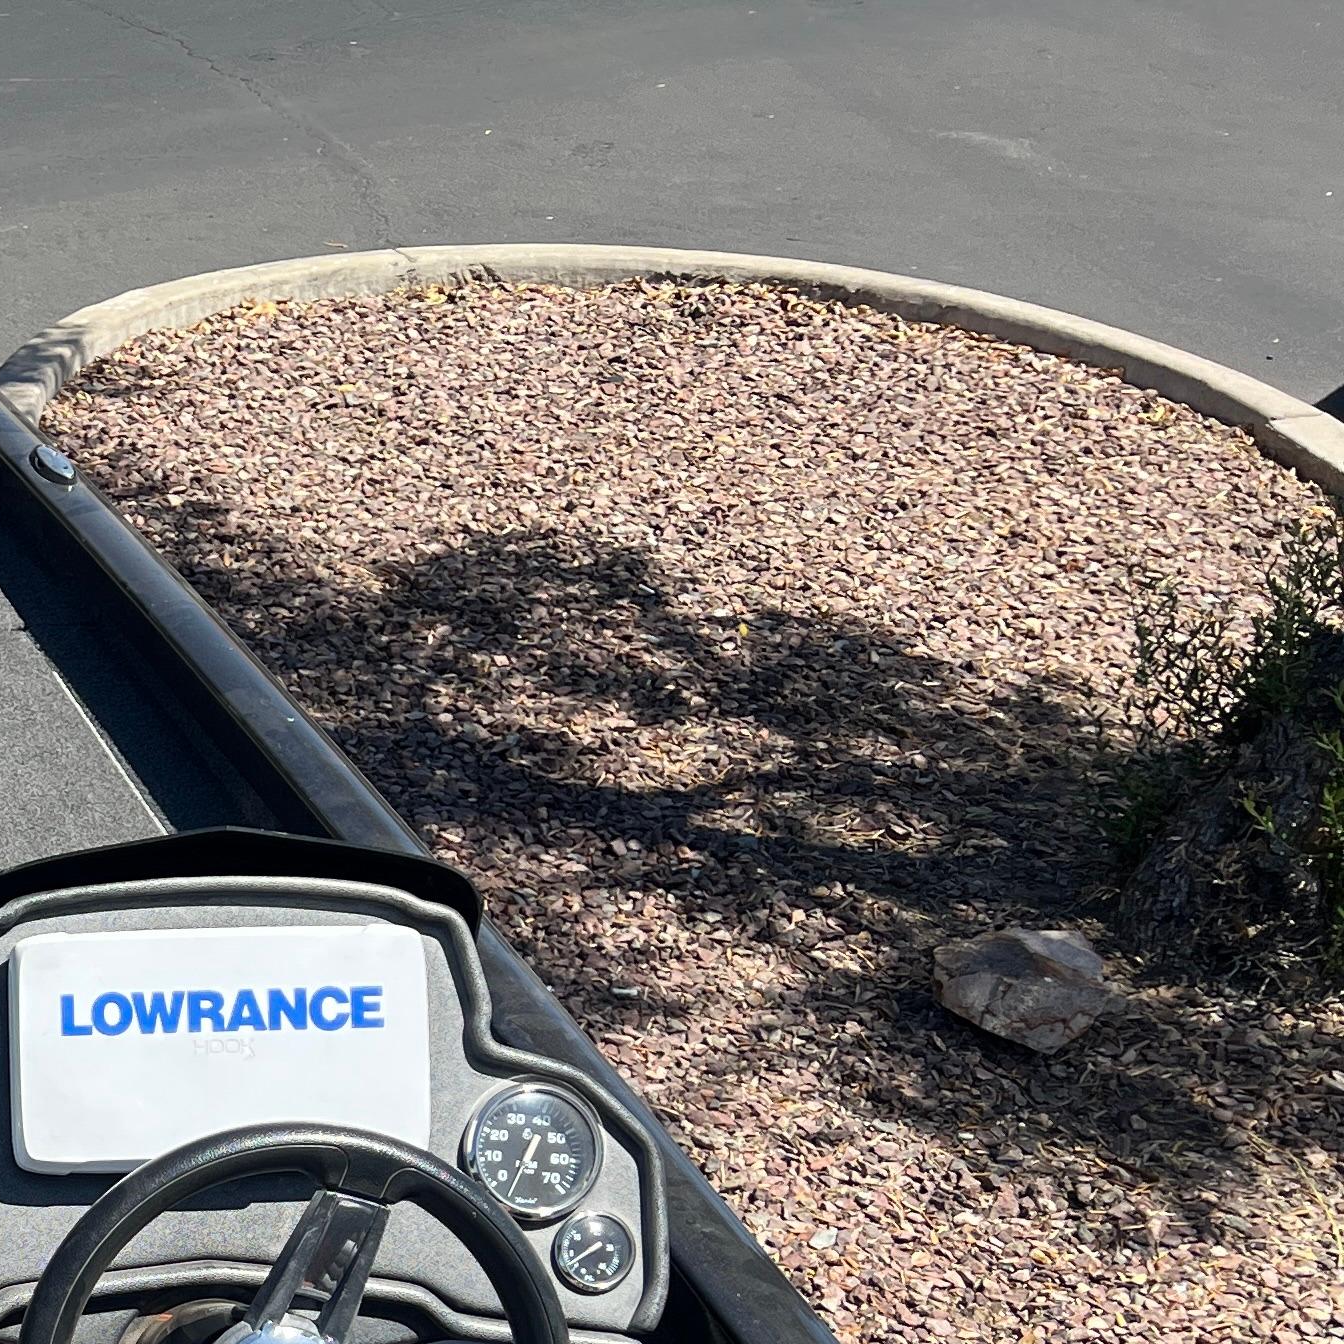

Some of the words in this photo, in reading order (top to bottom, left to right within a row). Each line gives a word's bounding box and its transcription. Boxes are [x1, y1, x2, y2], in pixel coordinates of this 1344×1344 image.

[60, 986, 385, 1037] LOWRANCE
[507, 1113, 526, 1125] 30
[532, 1115, 551, 1126] 40
[490, 1129, 509, 1141] 20
[547, 1132, 566, 1144] 50
[484, 1150, 503, 1161] 10
[550, 1153, 569, 1165] 60
[497, 1170, 508, 1181] 0
[541, 1171, 561, 1184] 70
